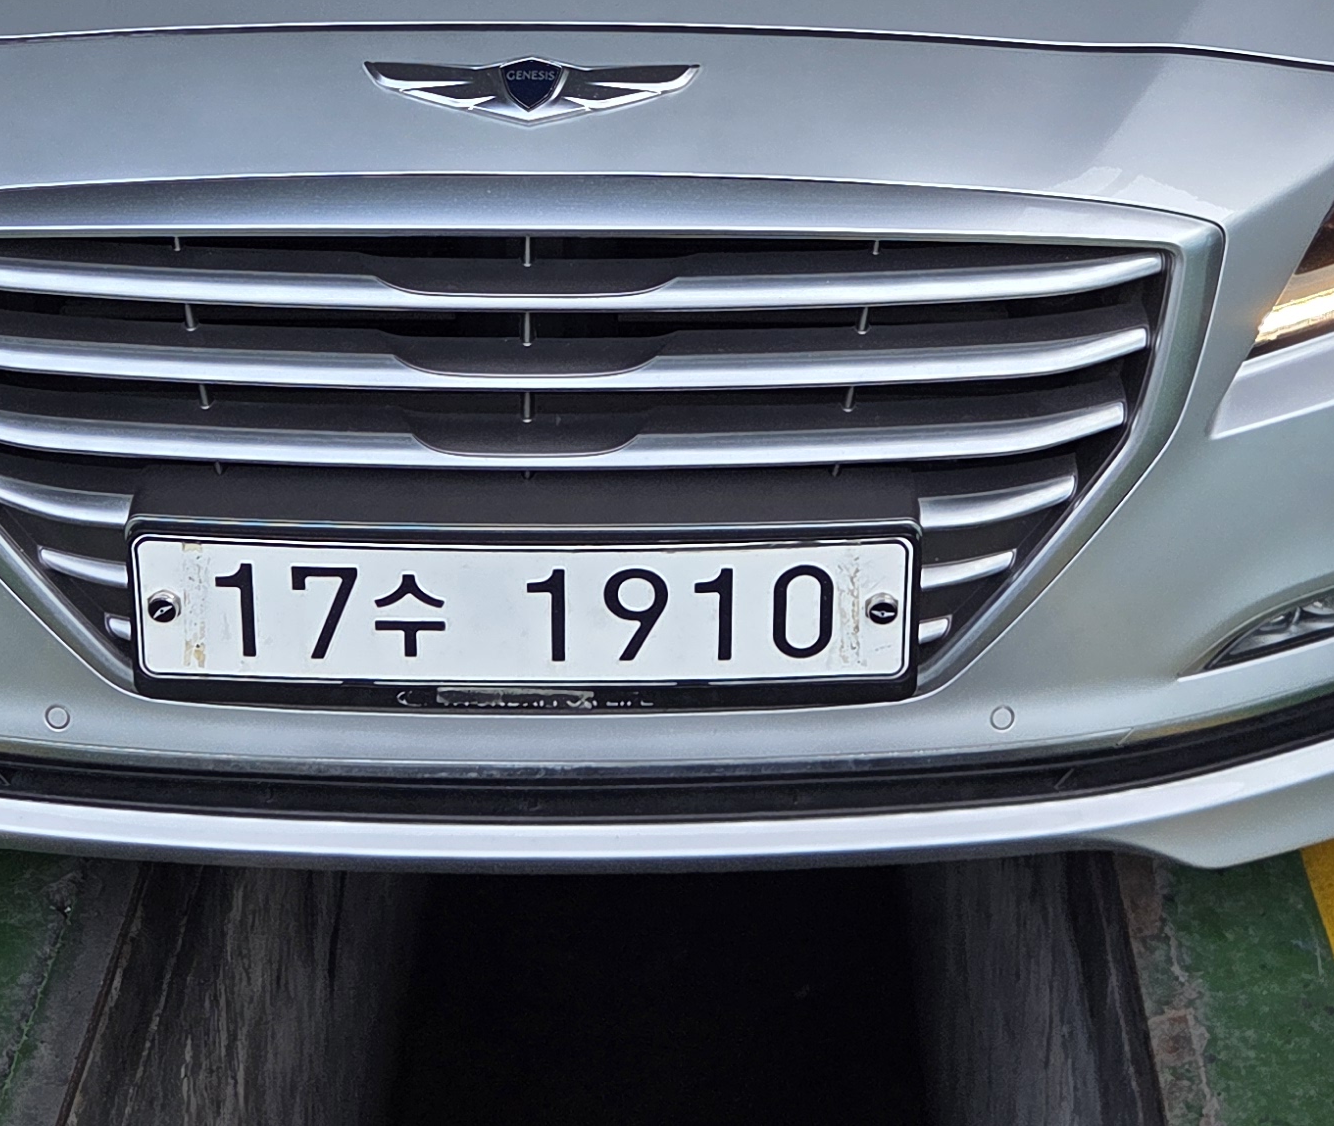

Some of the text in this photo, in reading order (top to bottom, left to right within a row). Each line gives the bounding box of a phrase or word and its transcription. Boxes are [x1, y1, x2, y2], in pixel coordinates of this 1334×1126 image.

[505, 69, 556, 82] GENESIS
[214, 562, 835, 662] 17수 1910
